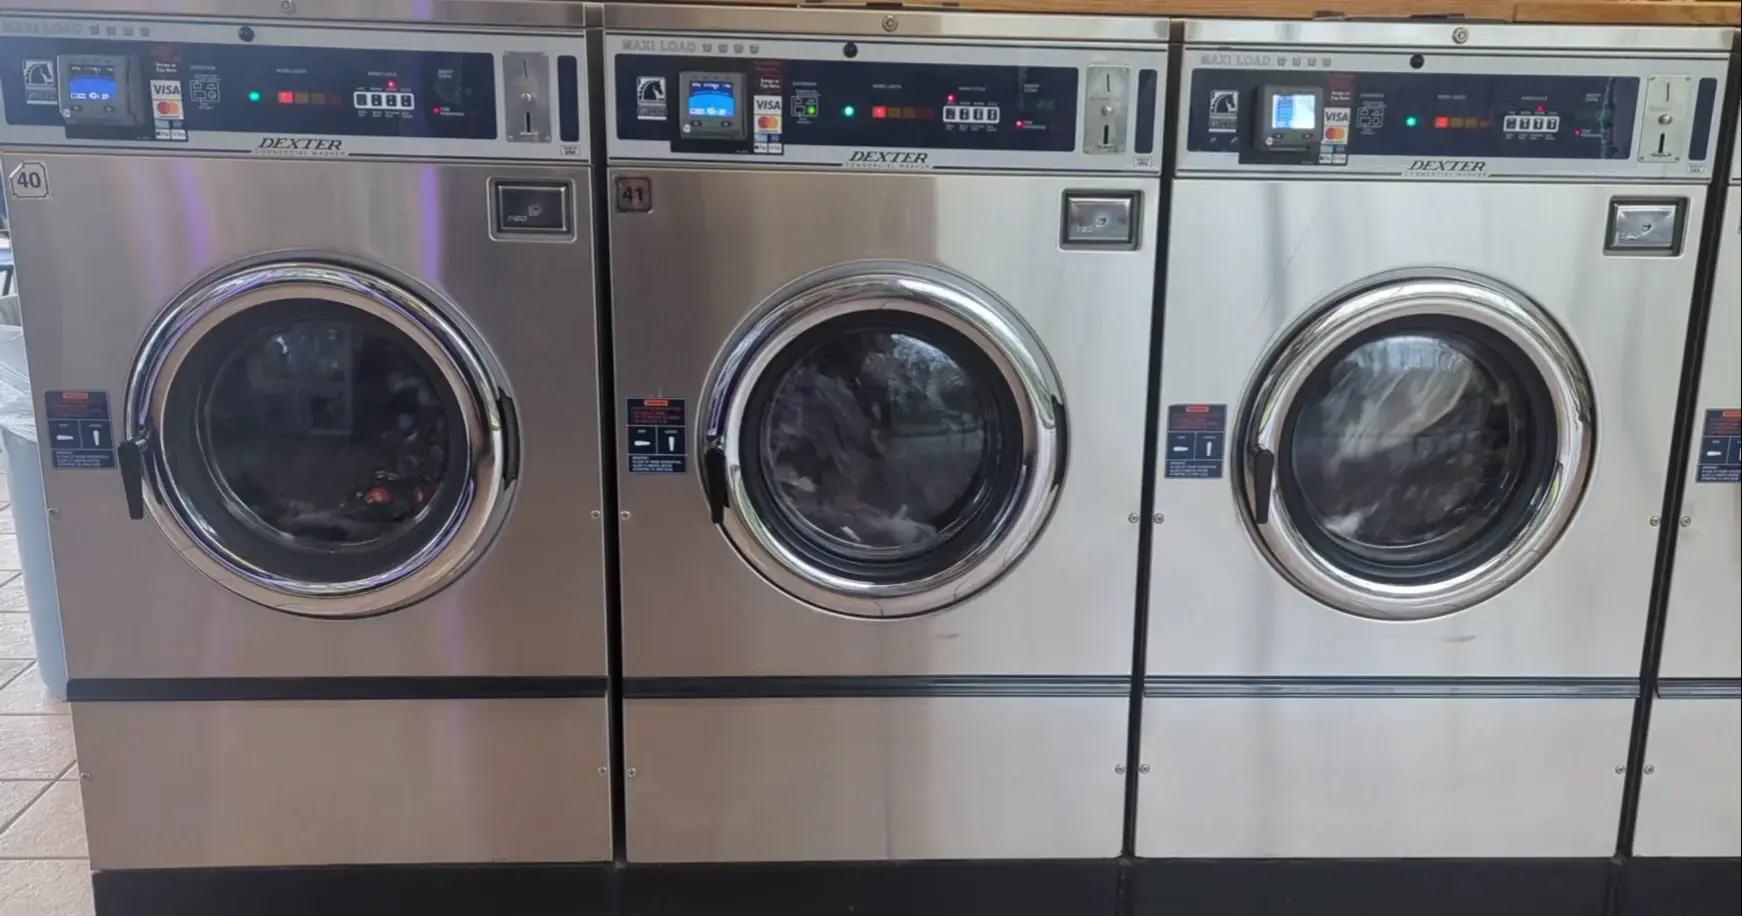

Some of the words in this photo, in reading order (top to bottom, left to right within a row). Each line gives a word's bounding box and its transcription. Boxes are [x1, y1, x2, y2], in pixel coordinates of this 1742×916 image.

[621, 39, 655, 51] MAXI
[660, 40, 696, 52] LOAD
[1200, 54, 1232, 65] MAXI
[1237, 55, 1271, 66] LOAD
[154, 84, 180, 96] VISA
[756, 100, 780, 110] VISA
[1325, 112, 1348, 122] VISA
[258, 137, 342, 150] DEXTER
[848, 151, 928, 163] DEXTER
[1408, 160, 1486, 172] DEXTER
[17, 171, 42, 188] 40
[622, 186, 643, 204] 41
